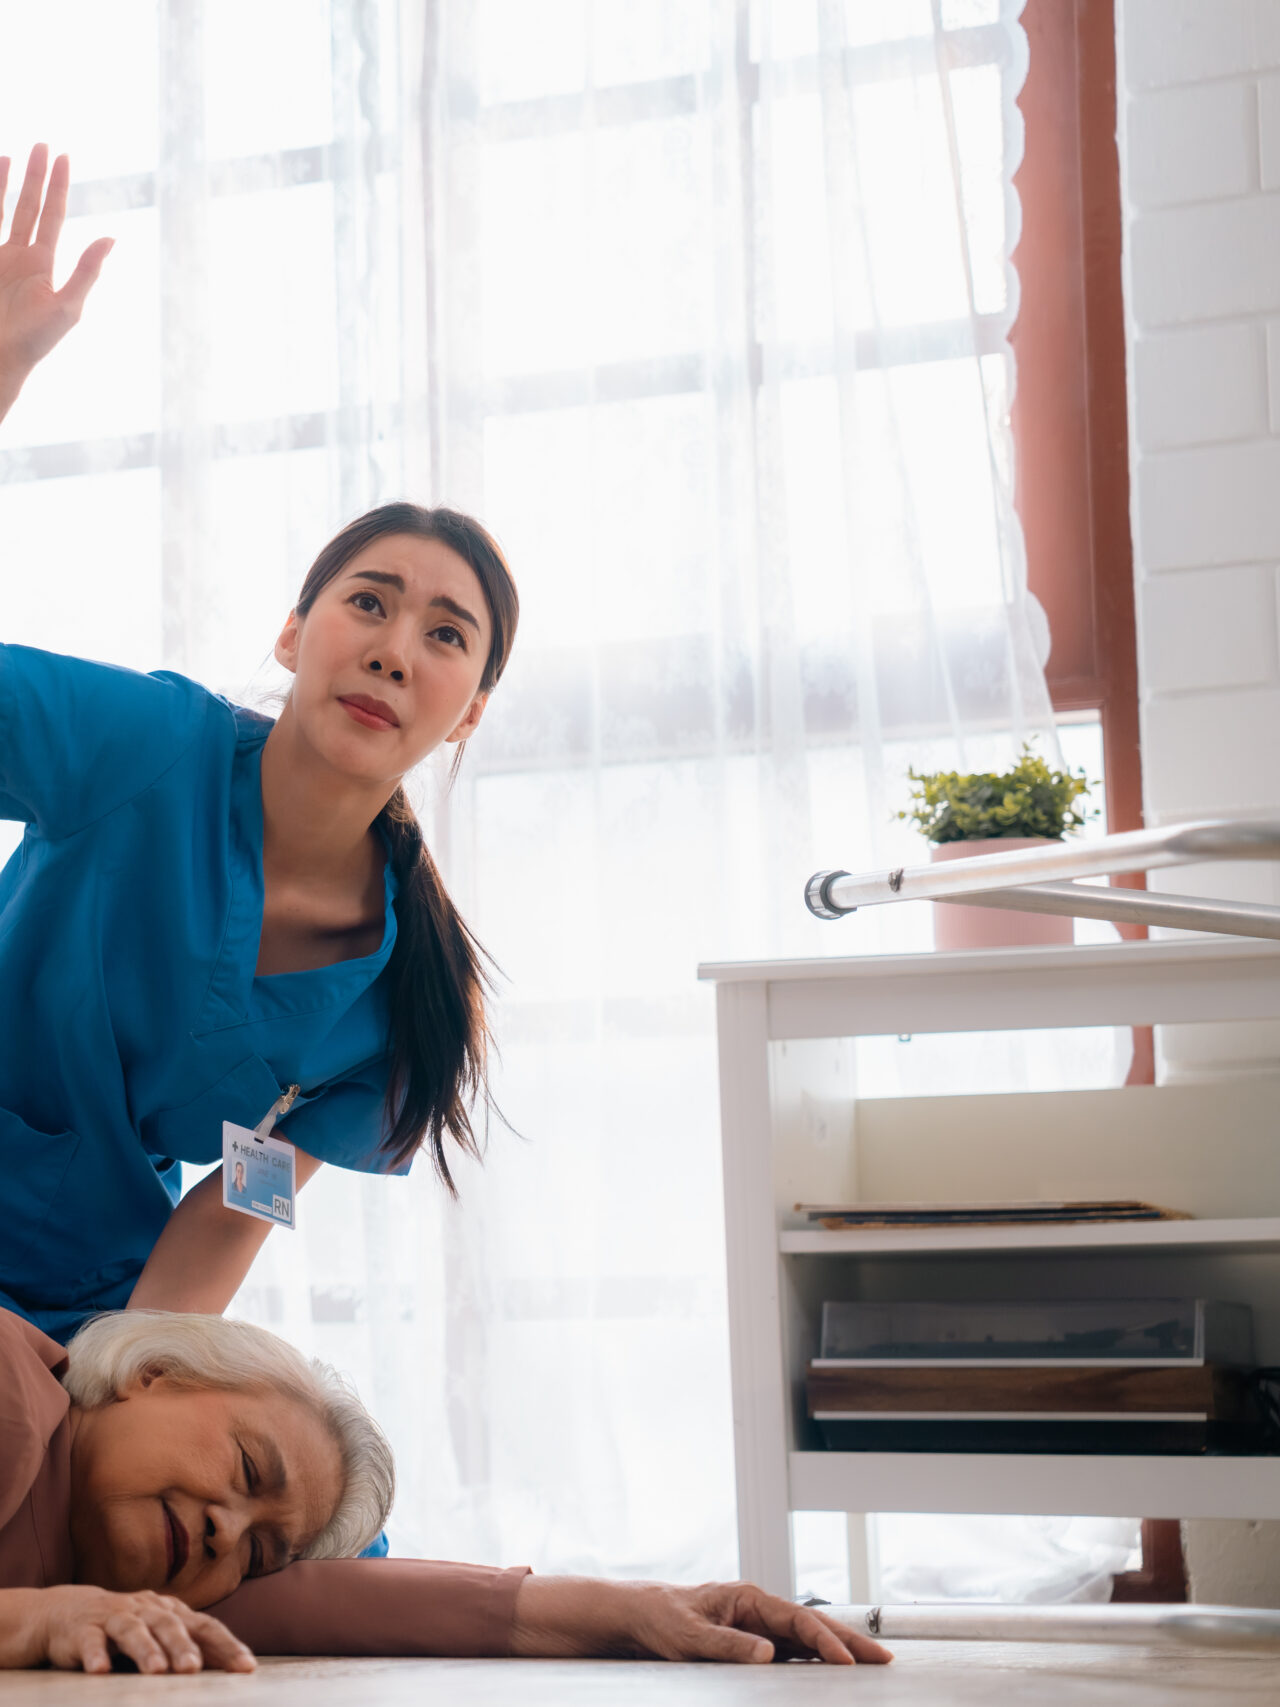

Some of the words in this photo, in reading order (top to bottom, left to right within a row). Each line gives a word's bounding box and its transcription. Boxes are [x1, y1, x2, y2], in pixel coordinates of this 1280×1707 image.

[240, 1144, 269, 1164] HEALTH
[272, 1157, 291, 1172] CARE
[274, 1199, 290, 1218] RN
